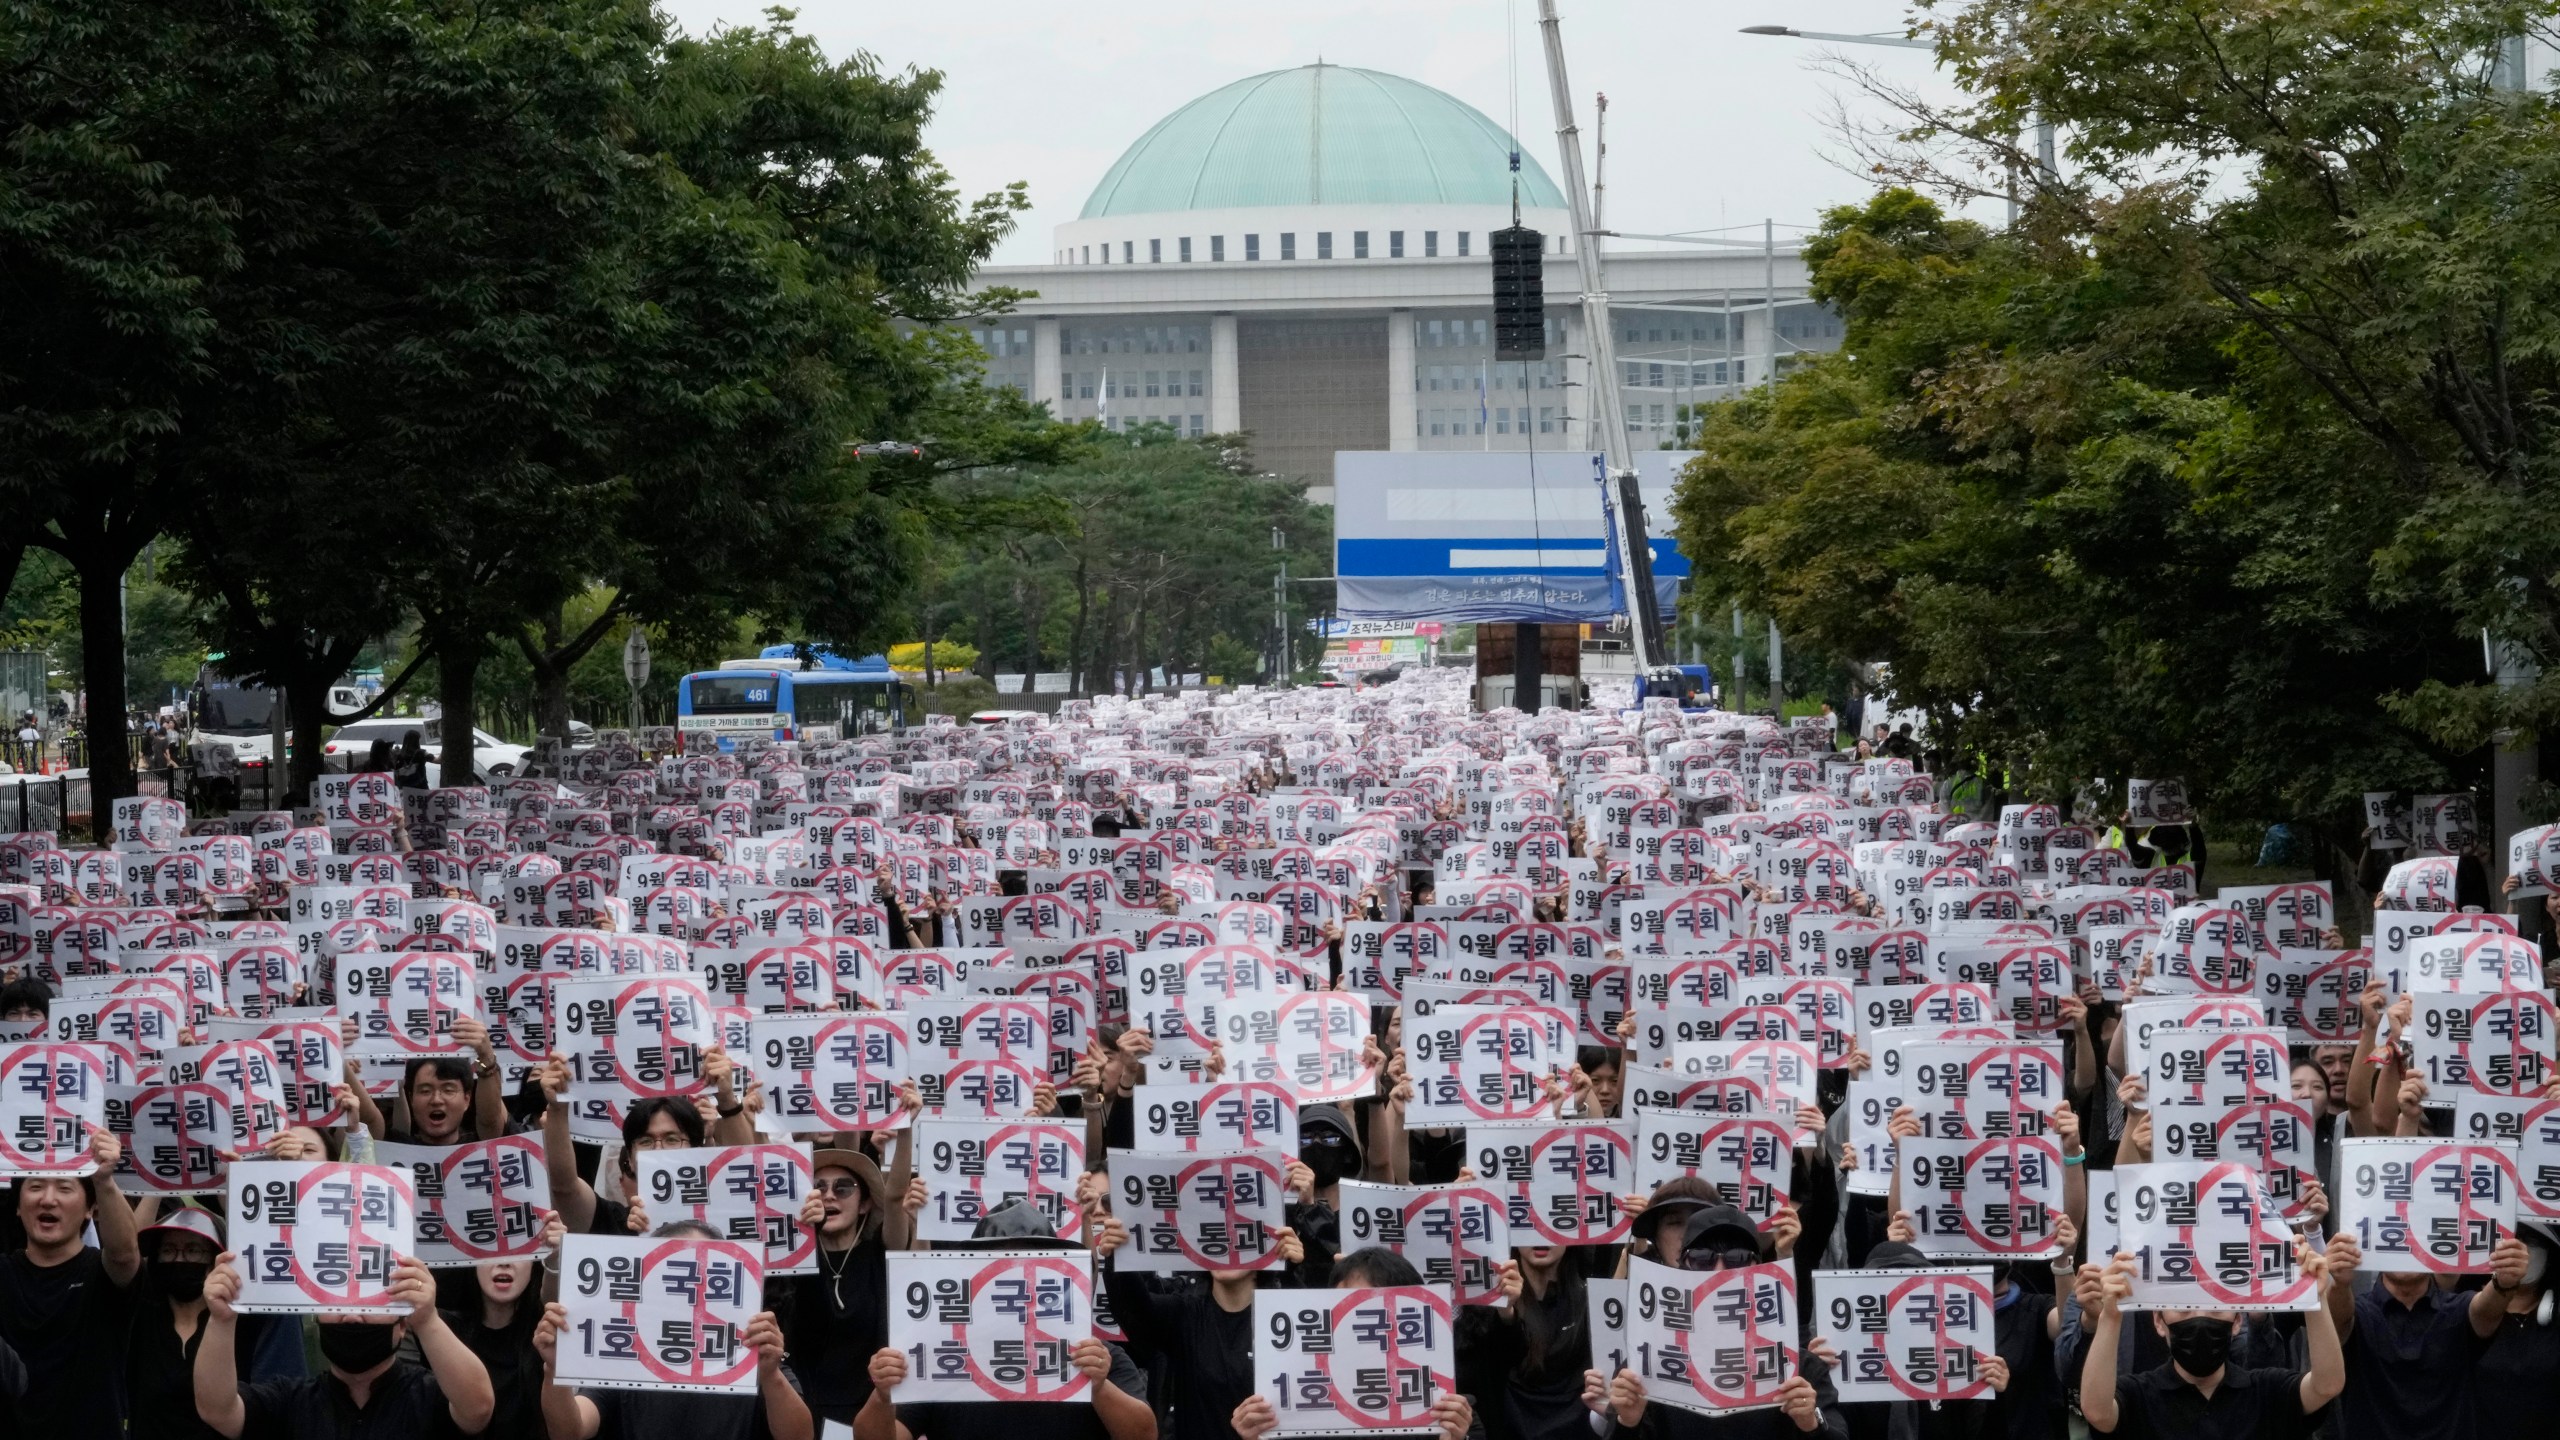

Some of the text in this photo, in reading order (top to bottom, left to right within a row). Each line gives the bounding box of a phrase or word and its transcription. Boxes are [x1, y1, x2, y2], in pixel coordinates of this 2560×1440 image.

[1425, 589, 1450, 602] 검은
[1500, 588, 1539, 603] 멈추지
[1544, 589, 1587, 604] 않는다.
[748, 689, 767, 701] 461
[718, 718, 740, 726] 가까운
[325, 778, 388, 797] 9월 국회
[327, 802, 389, 821] 1호 통과
[810, 823, 876, 845] 9월 국회
[1492, 839, 1560, 859] 9월 국회
[1635, 836, 1704, 856] 9월 국회
[810, 854, 831, 869] 1호
[1637, 863, 1703, 881] 1호 통과
[1779, 856, 1848, 877] 9월 국회
[513, 880, 596, 905] 9월 국회
[1782, 884, 1848, 902] 1호 통과
[517, 909, 597, 927] 1호 통과
[2165, 918, 2248, 947] 9월 국회
[348, 965, 463, 996] 9월 국회
[1140, 959, 1261, 995] 9월 국회
[2012, 959, 2061, 985] 국회
[2157, 953, 2249, 982] 1호 통과
[2266, 972, 2307, 995] 9월
[58, 1010, 165, 1041] 9월 국회
[404, 1010, 461, 1039] 통과
[566, 996, 699, 1034] 9월 국회
[1144, 1010, 1188, 1040] 1호
[1228, 1007, 1356, 1044] 9월 국회
[2010, 996, 2061, 1020] 통과
[2266, 1008, 2362, 1030] 1호 통과
[2425, 1005, 2543, 1042] 9월 국회
[917, 1016, 1034, 1048] 9월 국회
[1416, 1025, 1534, 1062] 9월 국회
[569, 1045, 701, 1083] 1호 통과
[766, 1033, 894, 1068] 9월 국회
[1295, 1051, 1360, 1085] 통과
[2160, 1048, 2277, 1082] 9월 국회
[18, 1061, 89, 1102] 국회
[216, 1054, 272, 1090] 국회
[1917, 1063, 2049, 1097] 9월 국회
[2426, 1054, 2543, 1086] 1호 통과
[769, 1083, 894, 1116] 1호 통과
[1418, 1072, 1536, 1106] 1호 통과
[149, 1098, 216, 1134] 국회
[1148, 1098, 1282, 1138] 9월 국회
[15, 1115, 86, 1154] 통과
[1651, 1133, 1777, 1170] 9월 국회
[2166, 1118, 2298, 1158] 9월 국회
[152, 1145, 218, 1178] 통과
[461, 1151, 532, 1192] 국회
[932, 1140, 1068, 1178] 9월 국회
[1480, 1142, 1616, 1182] 9월 국회
[1913, 1152, 2049, 1190] 9월 국회
[652, 1162, 796, 1202] 9월 국회
[1124, 1170, 1266, 1209] 9월 국회
[2356, 1162, 2501, 1203] 9월 국회
[242, 1181, 396, 1228] 9월 국회
[936, 1191, 984, 1224] 1호
[1549, 1192, 1616, 1229] 통과
[1915, 1204, 2050, 1237] 1호 통과
[2135, 1181, 2281, 1225] 9월 국회
[464, 1202, 536, 1245] 통과
[1128, 1220, 1268, 1255] 1호 통과
[1352, 1204, 1492, 1242] 9월 국회
[2356, 1217, 2501, 1255] 1호 통과
[242, 1242, 395, 1288] 1호 통과
[578, 1256, 744, 1306] 9월 국회
[2137, 1243, 2297, 1285] 1호 통과
[906, 1278, 1072, 1322] 9월 국회
[1639, 1281, 1784, 1331] 9월 국회
[1831, 1292, 1977, 1333] 9월 국회
[578, 1318, 742, 1366] 1호 통과
[1270, 1305, 1434, 1354] 9월 국회
[909, 1340, 1072, 1382] 1호 통과
[1637, 1342, 1788, 1390] 1호 통과
[1837, 1347, 1978, 1384] 1호 통과
[1274, 1366, 1435, 1411] 1호 통과
